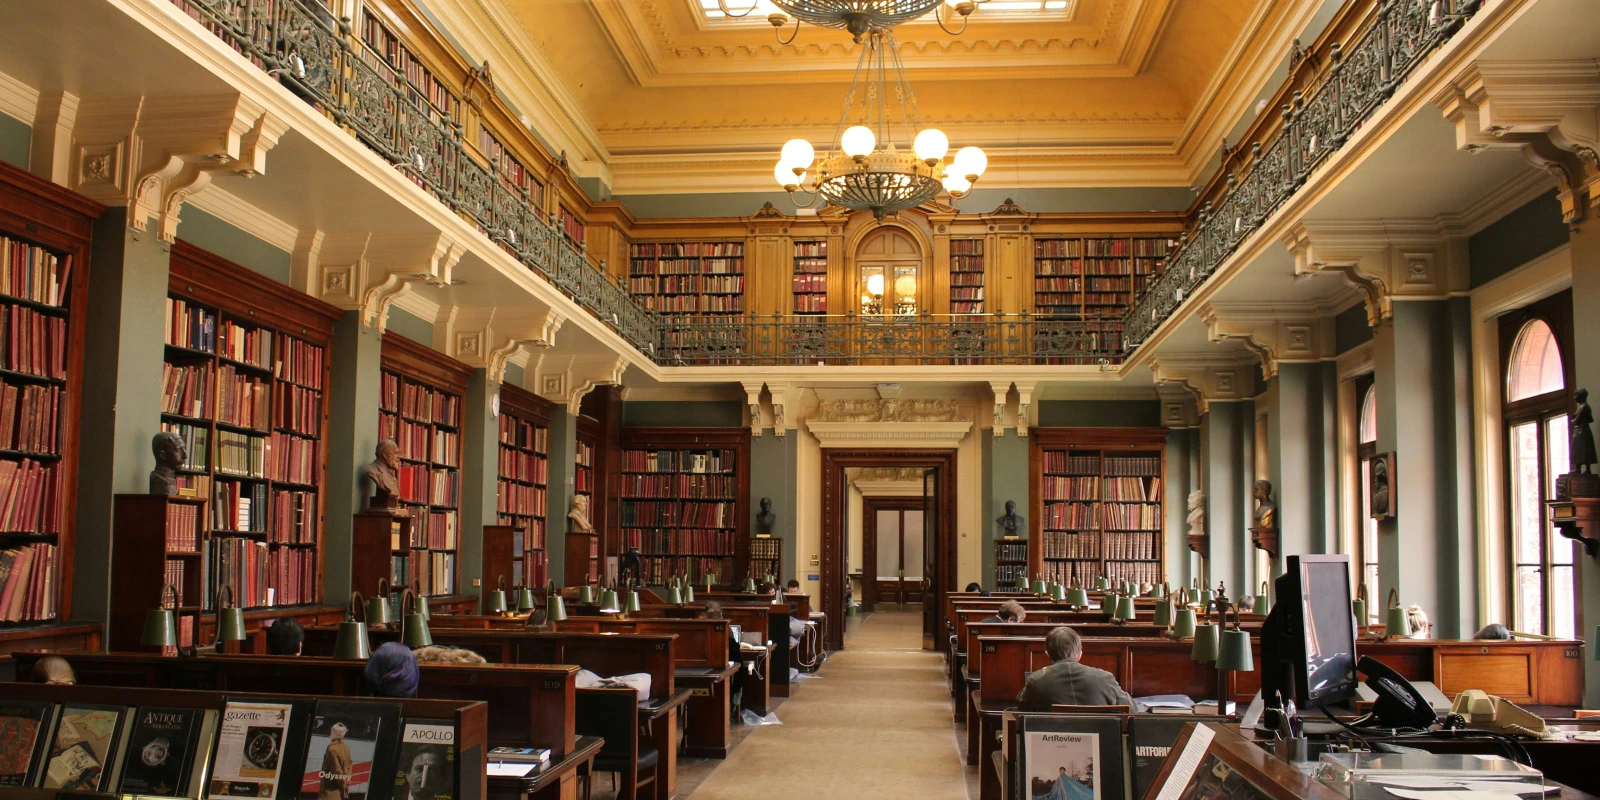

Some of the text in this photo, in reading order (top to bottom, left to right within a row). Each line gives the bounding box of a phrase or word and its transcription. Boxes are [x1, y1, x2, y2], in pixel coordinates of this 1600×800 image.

[544, 680, 560, 689] 109
[143, 711, 184, 724] ANTIQUE
[224, 711, 261, 722] gazette
[411, 730, 453, 741] APOLLO
[1042, 734, 1082, 743] ArtReview
[1136, 746, 1172, 757] ARTFORU
[318, 770, 352, 781] Odyssey
